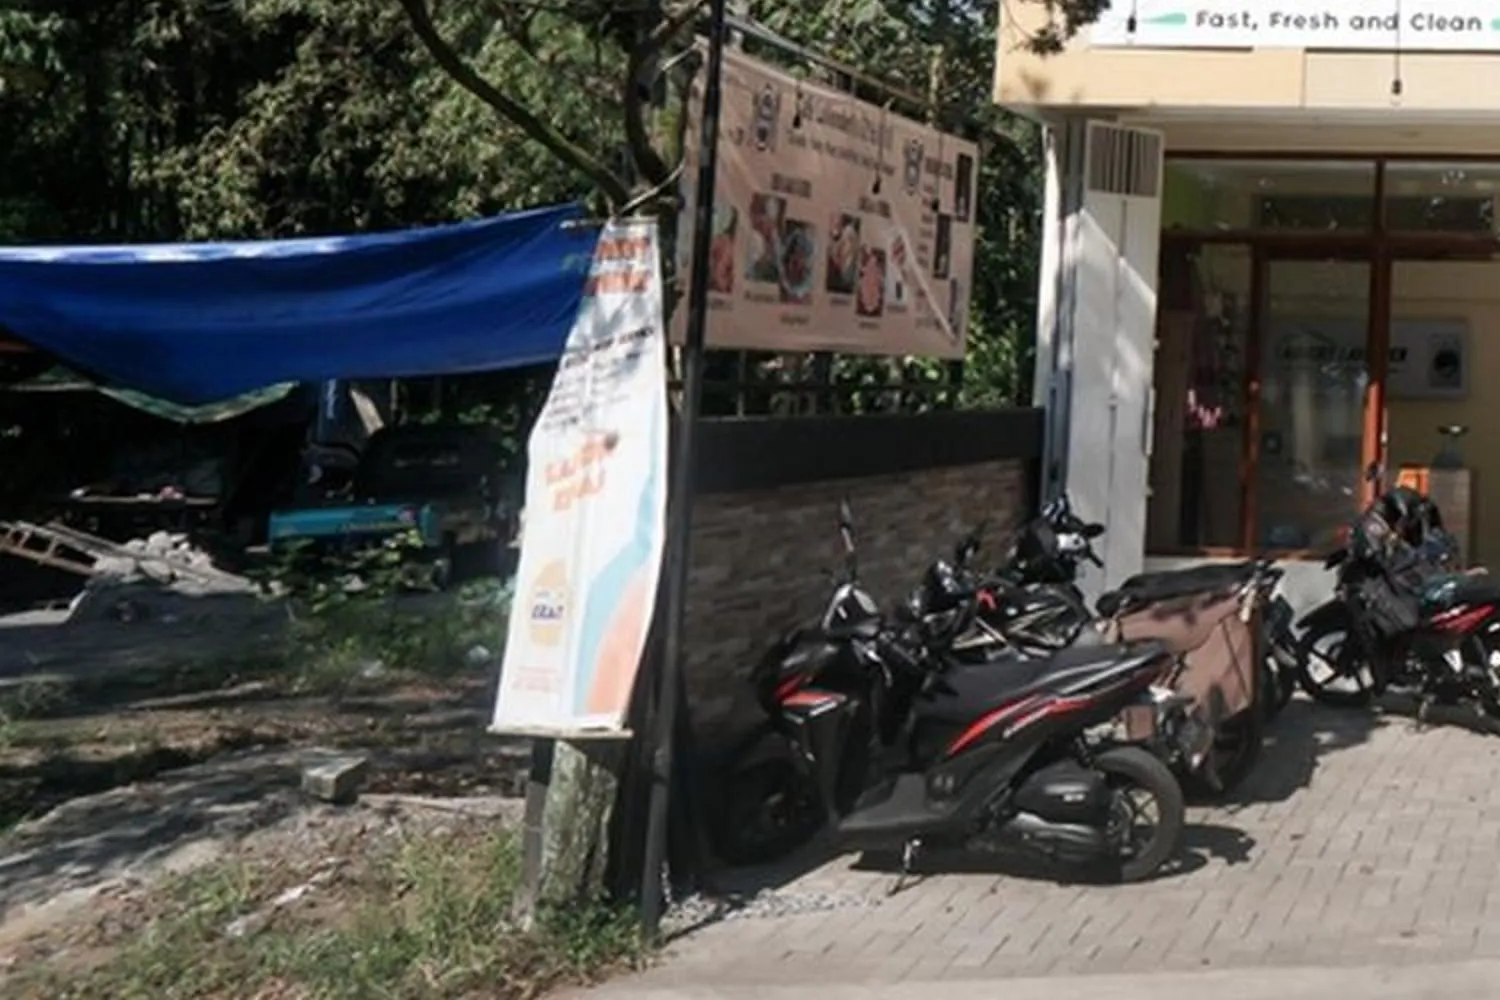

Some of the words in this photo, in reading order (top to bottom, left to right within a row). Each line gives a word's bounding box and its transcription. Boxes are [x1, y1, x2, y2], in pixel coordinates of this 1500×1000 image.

[1195, 10, 1259, 31] Fast,
[1269, 10, 1339, 29] Fresh
[1349, 12, 1400, 31] and
[1409, 12, 1483, 32] Clean
